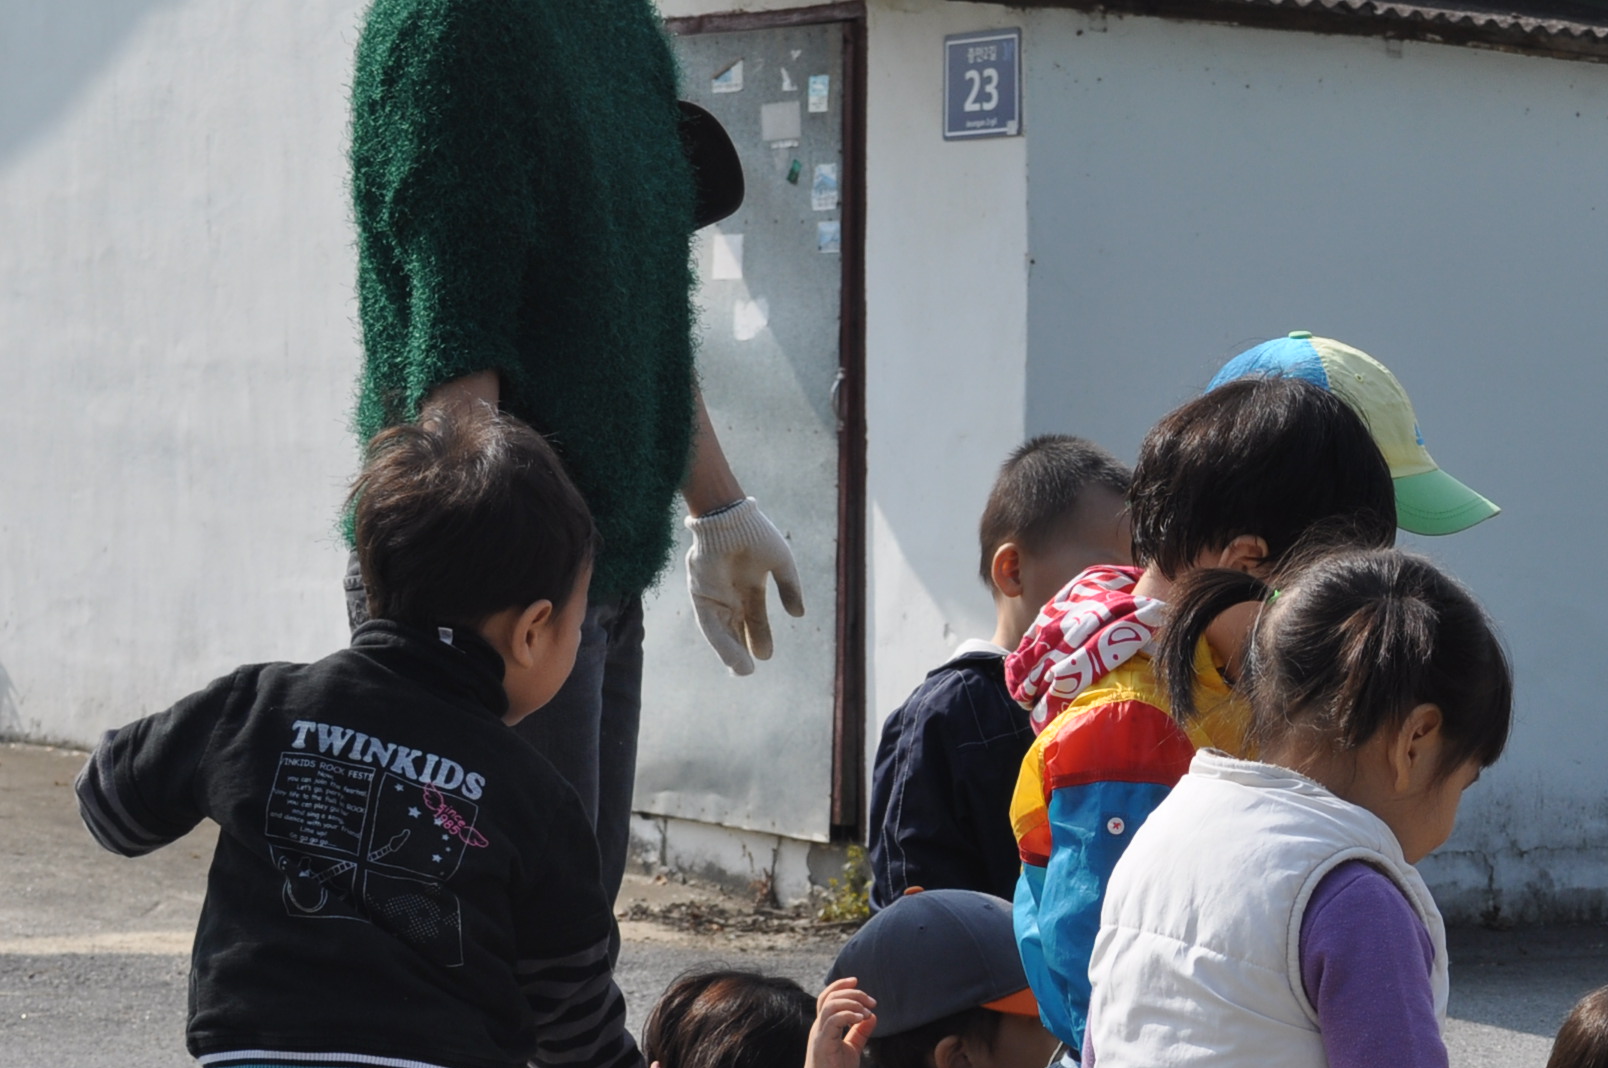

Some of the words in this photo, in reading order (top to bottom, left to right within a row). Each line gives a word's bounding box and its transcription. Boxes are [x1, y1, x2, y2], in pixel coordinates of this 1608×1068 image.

[964, 68, 999, 112] 23
[291, 720, 486, 800] TWINKIDS
[319, 762, 345, 774] ROCK
[433, 809, 461, 834] 1985
[440, 804, 466, 827] since
